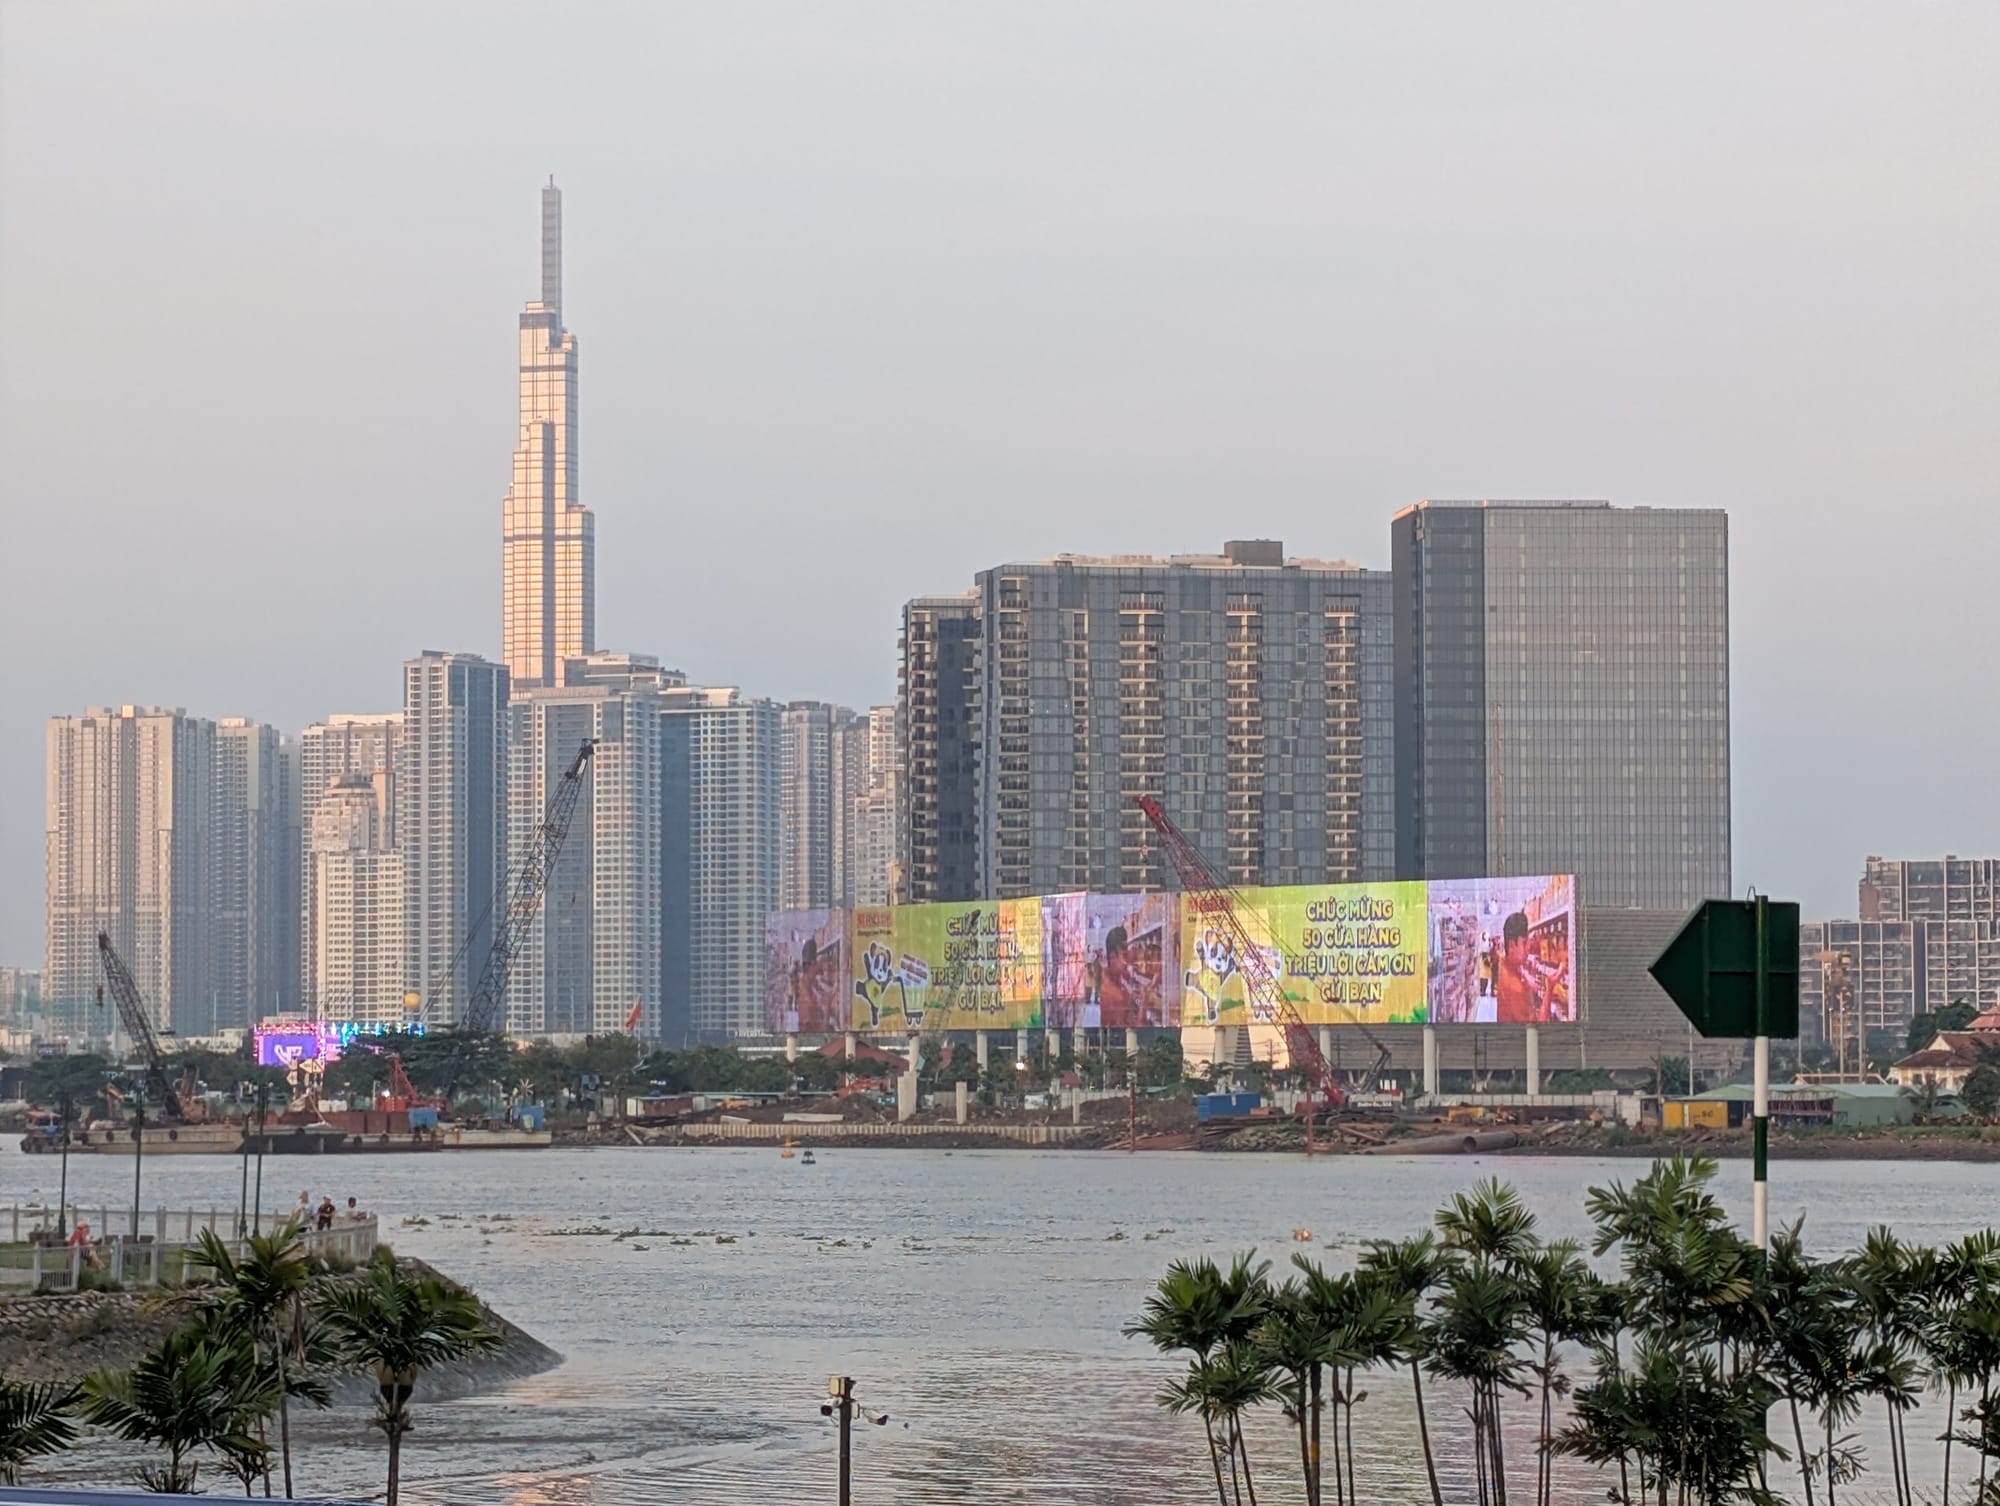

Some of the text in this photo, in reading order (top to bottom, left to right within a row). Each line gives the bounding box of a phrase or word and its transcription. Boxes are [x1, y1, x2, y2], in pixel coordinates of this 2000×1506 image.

[1306, 895, 1393, 921] CHÚC MỪNG
[1303, 922, 1401, 949] 50 CỬA HÀNG
[945, 942, 959, 961] 50
[1286, 952, 1328, 980] TRIỆU
[1329, 951, 1354, 976] LỜI
[1390, 952, 1415, 975] ƠN
[1349, 982, 1382, 1007] BẠN
